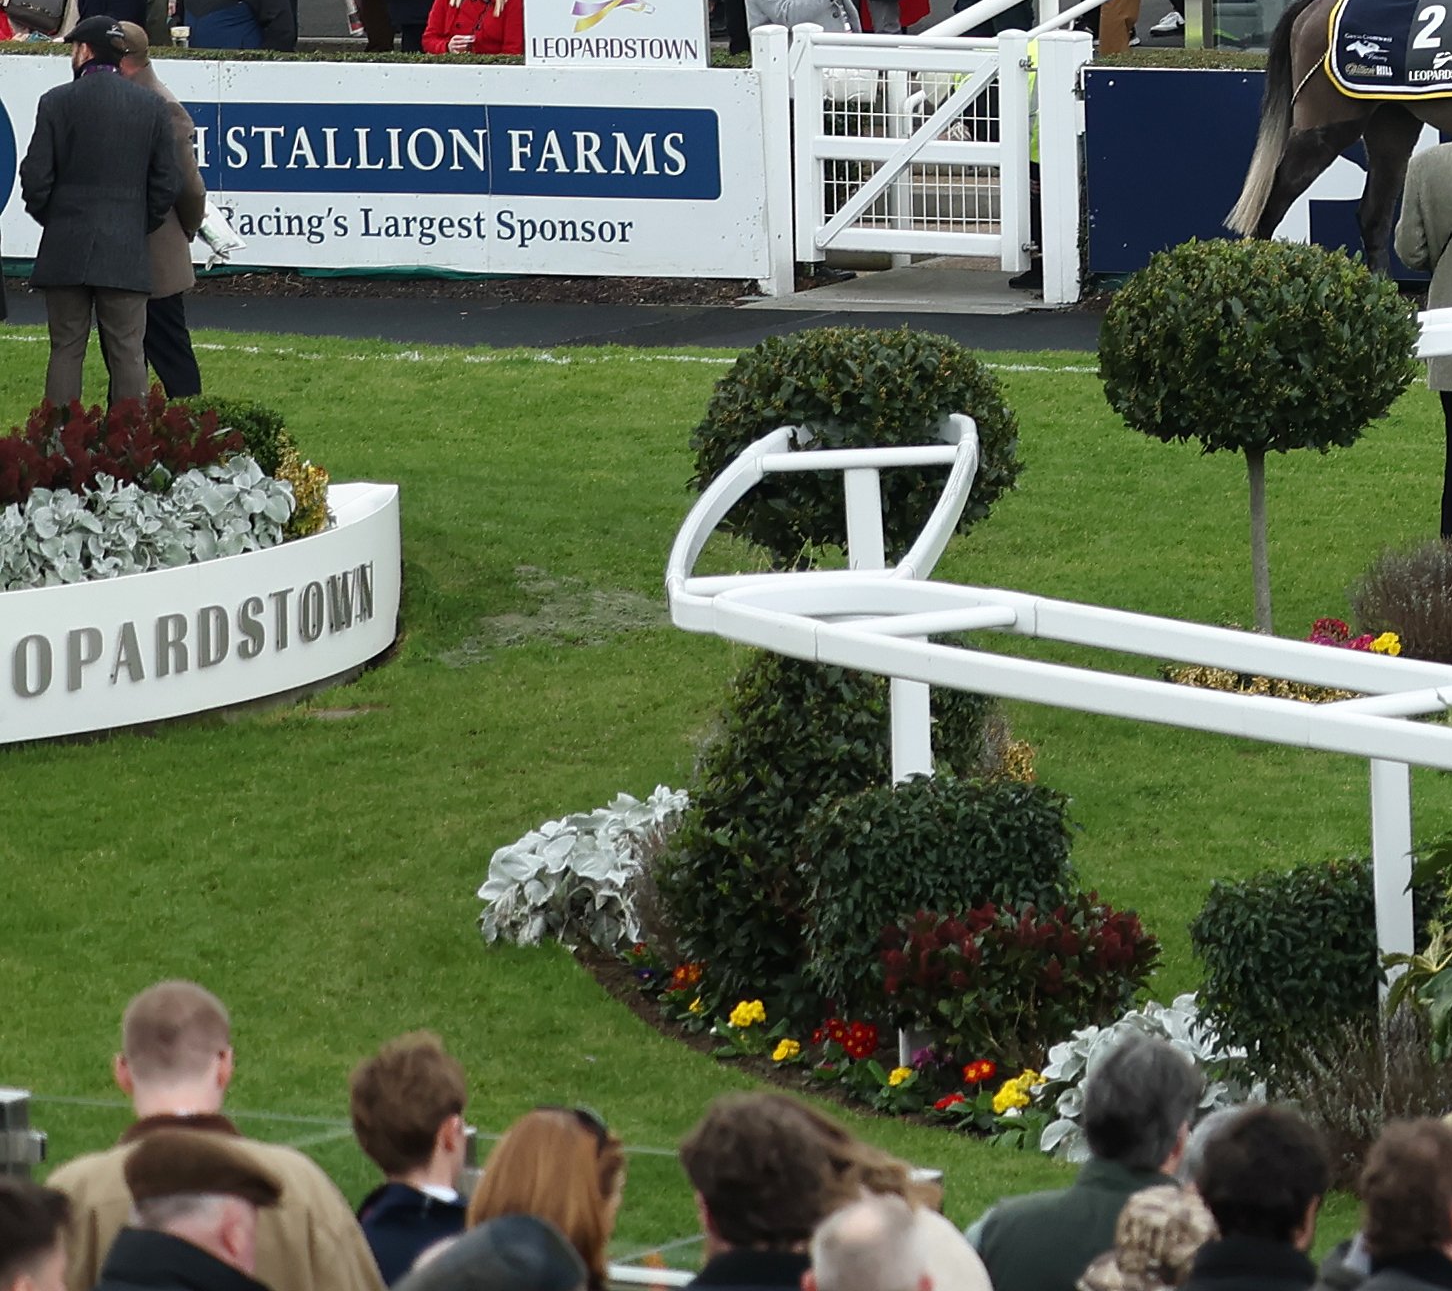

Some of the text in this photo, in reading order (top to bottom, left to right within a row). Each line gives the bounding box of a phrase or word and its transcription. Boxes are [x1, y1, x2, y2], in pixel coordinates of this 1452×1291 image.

[532, 35, 699, 61] LEOPARDSTOWN
[1412, 5, 1447, 50] 2
[226, 125, 487, 172] STALLION
[507, 130, 688, 178] FARMS
[360, 208, 486, 244] Largest
[497, 210, 634, 248] Sponsor
